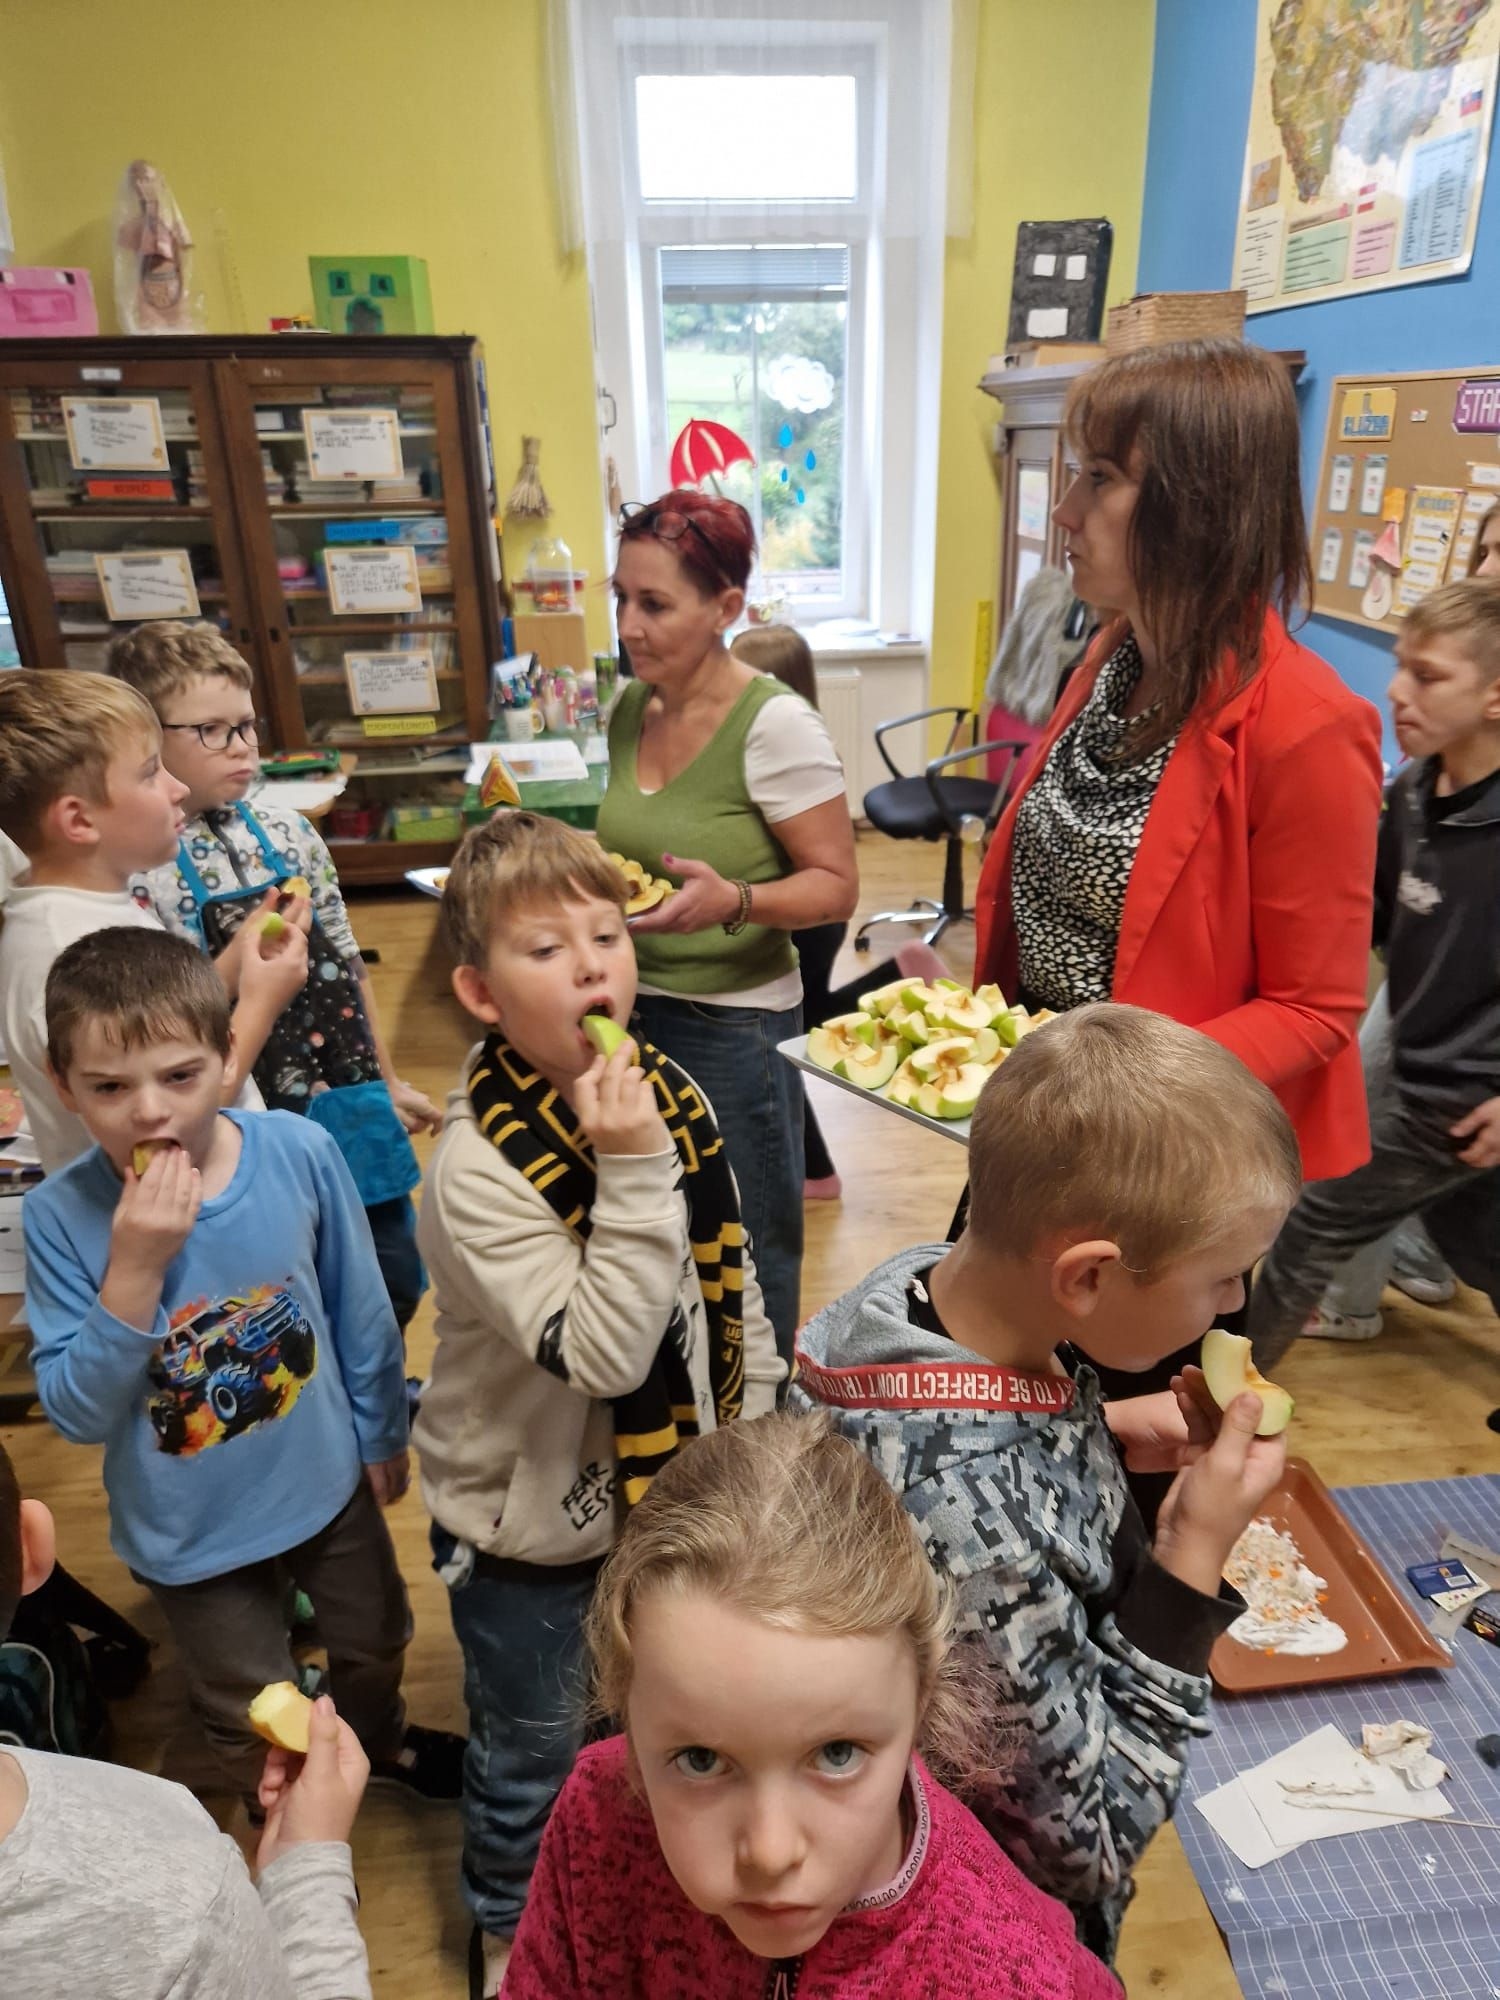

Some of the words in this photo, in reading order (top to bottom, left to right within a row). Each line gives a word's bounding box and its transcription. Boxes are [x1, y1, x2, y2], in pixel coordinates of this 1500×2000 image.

[837, 1375, 866, 1399] TRY
[912, 1371, 1002, 1402] PERFECT
[1008, 1376, 1031, 1403] BE
[1033, 1380, 1056, 1405] TO
[561, 1461, 608, 1514] FEAR
